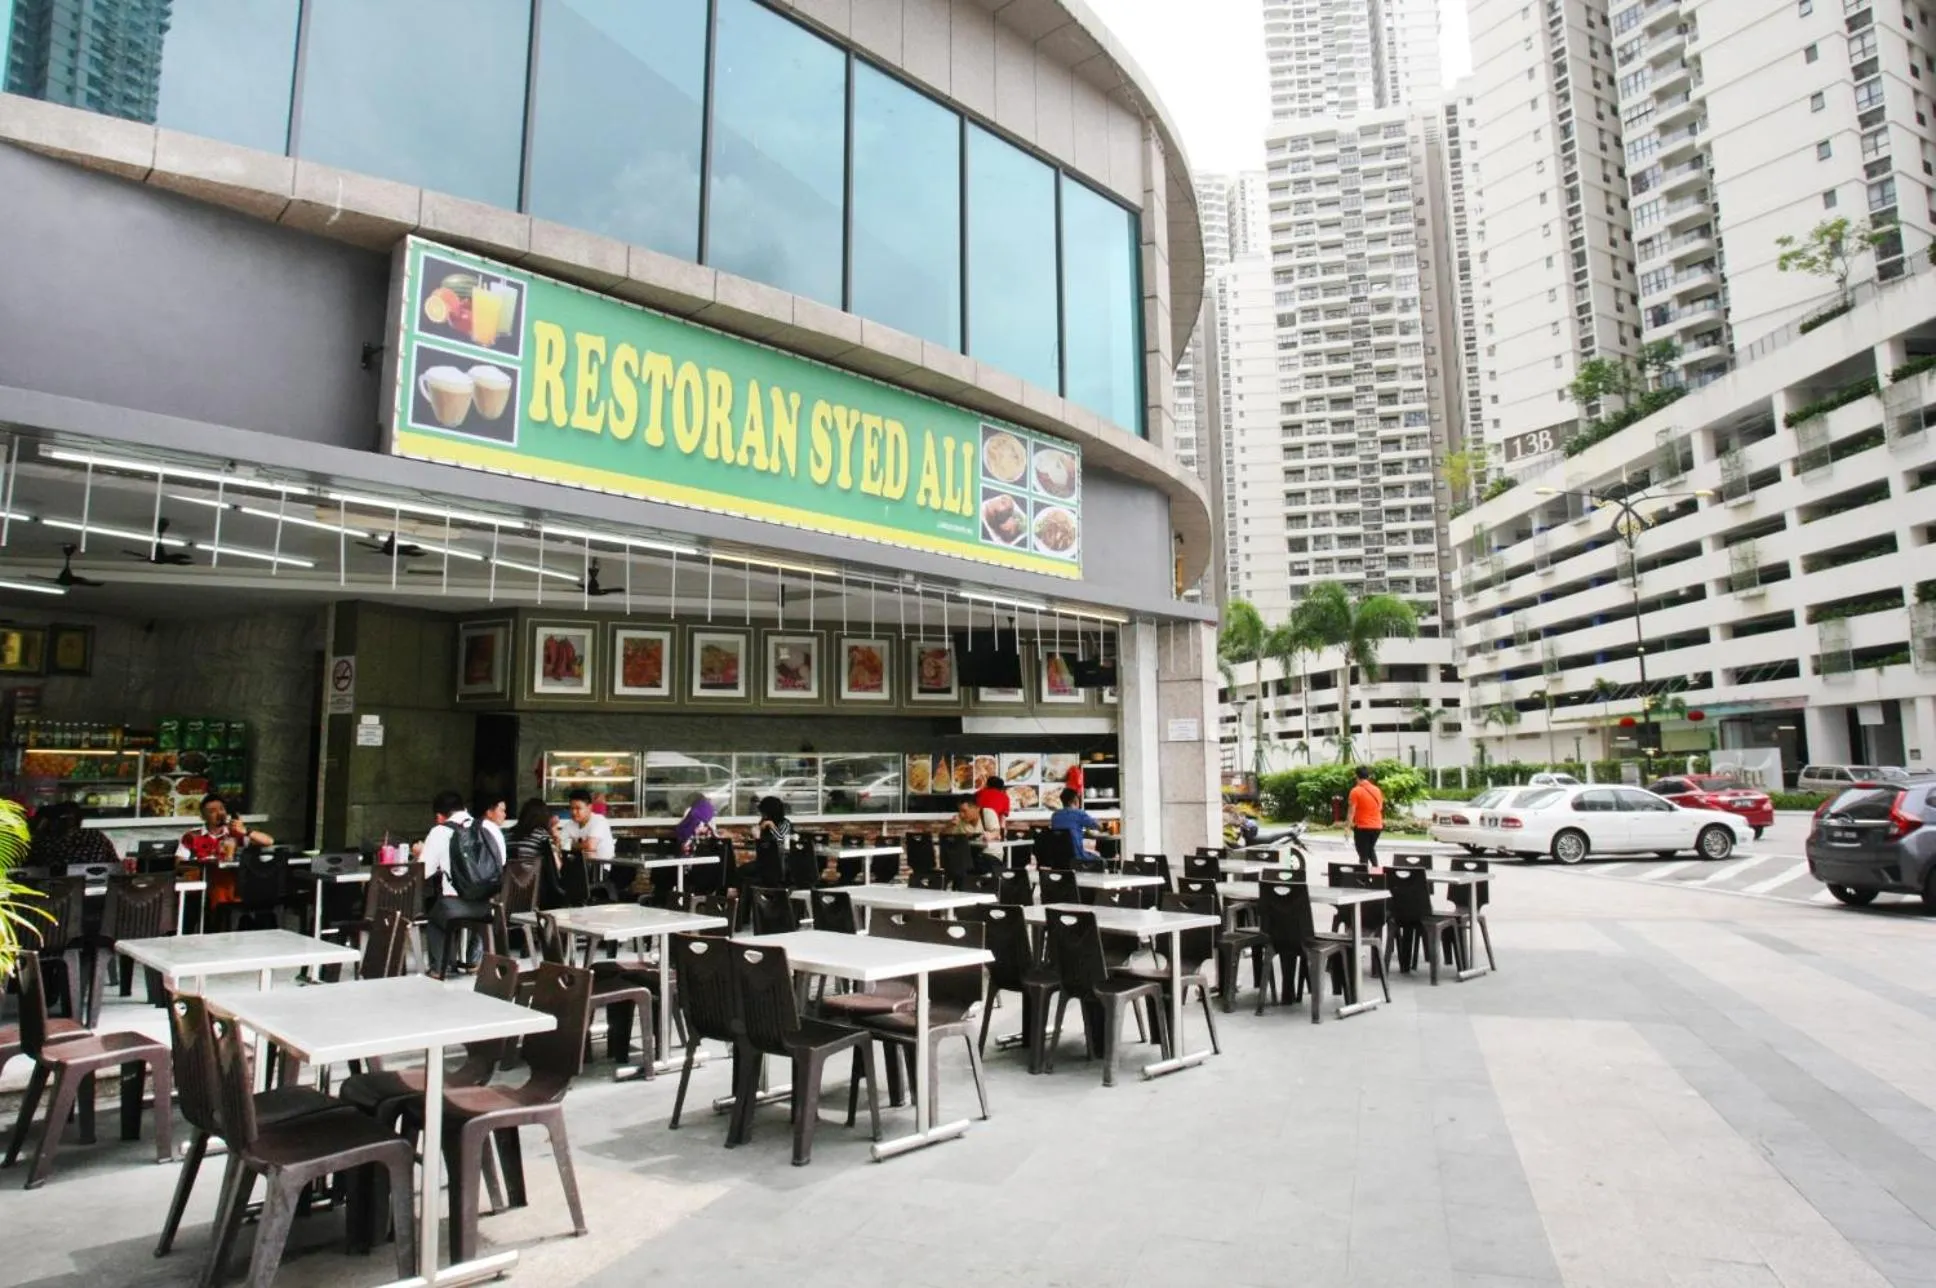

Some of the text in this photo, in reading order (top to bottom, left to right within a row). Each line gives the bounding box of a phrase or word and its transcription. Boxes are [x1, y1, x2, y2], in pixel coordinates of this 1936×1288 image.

[528, 320, 974, 517] RESTORAN SYED ALI
[1512, 429, 1554, 460] 13B
